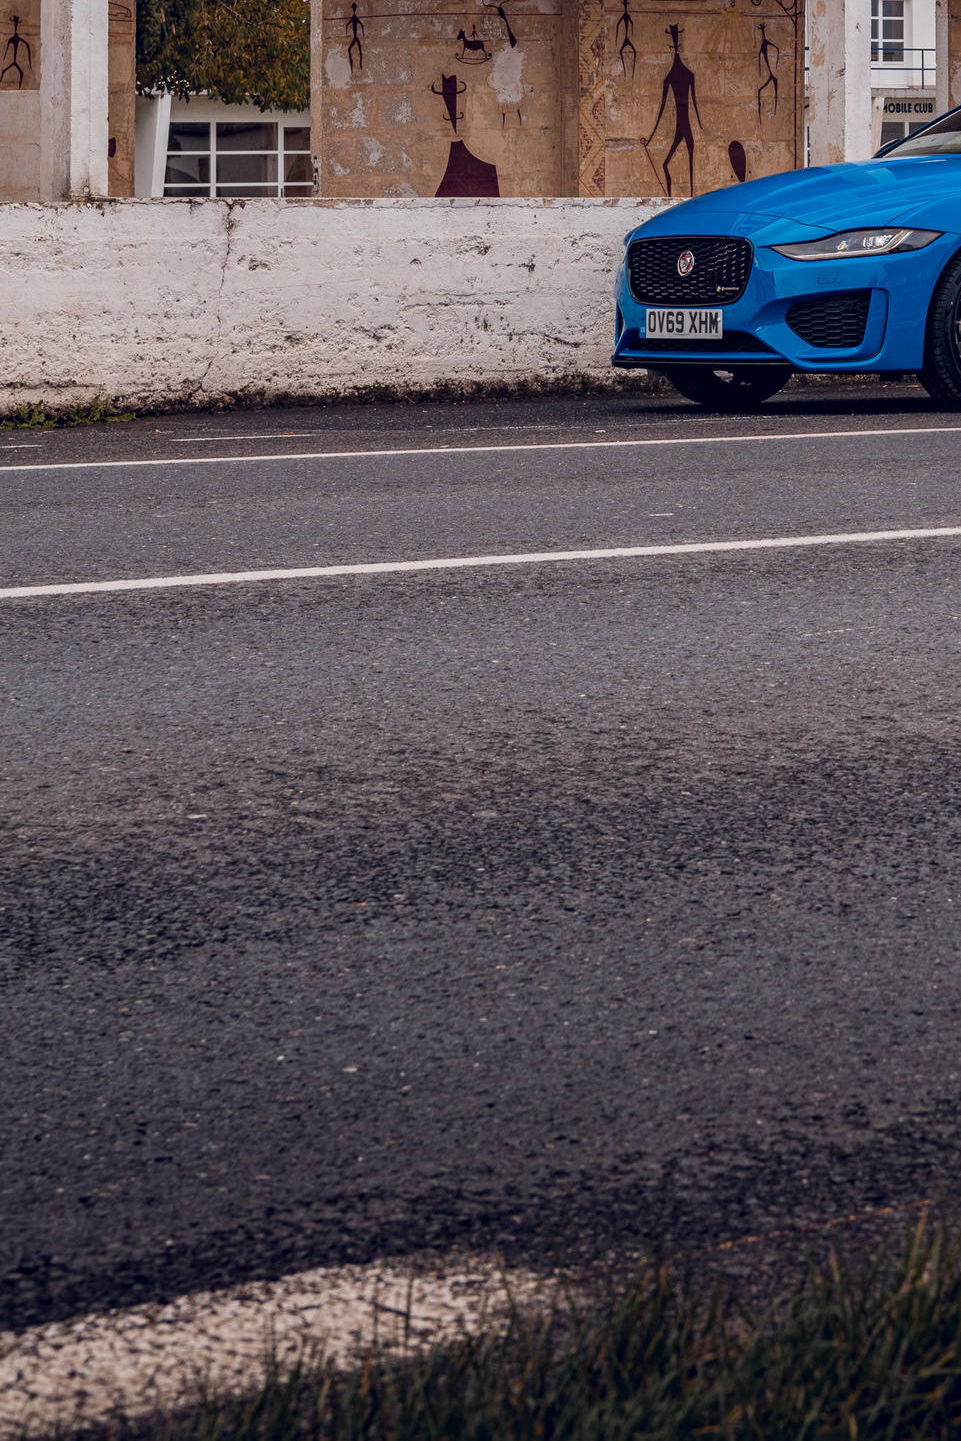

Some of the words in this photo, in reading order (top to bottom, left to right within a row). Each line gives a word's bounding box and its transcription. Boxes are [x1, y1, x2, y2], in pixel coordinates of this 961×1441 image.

[913, 103, 933, 113] CLUB
[648, 311, 684, 333] OV69
[688, 311, 719, 334] XHM
